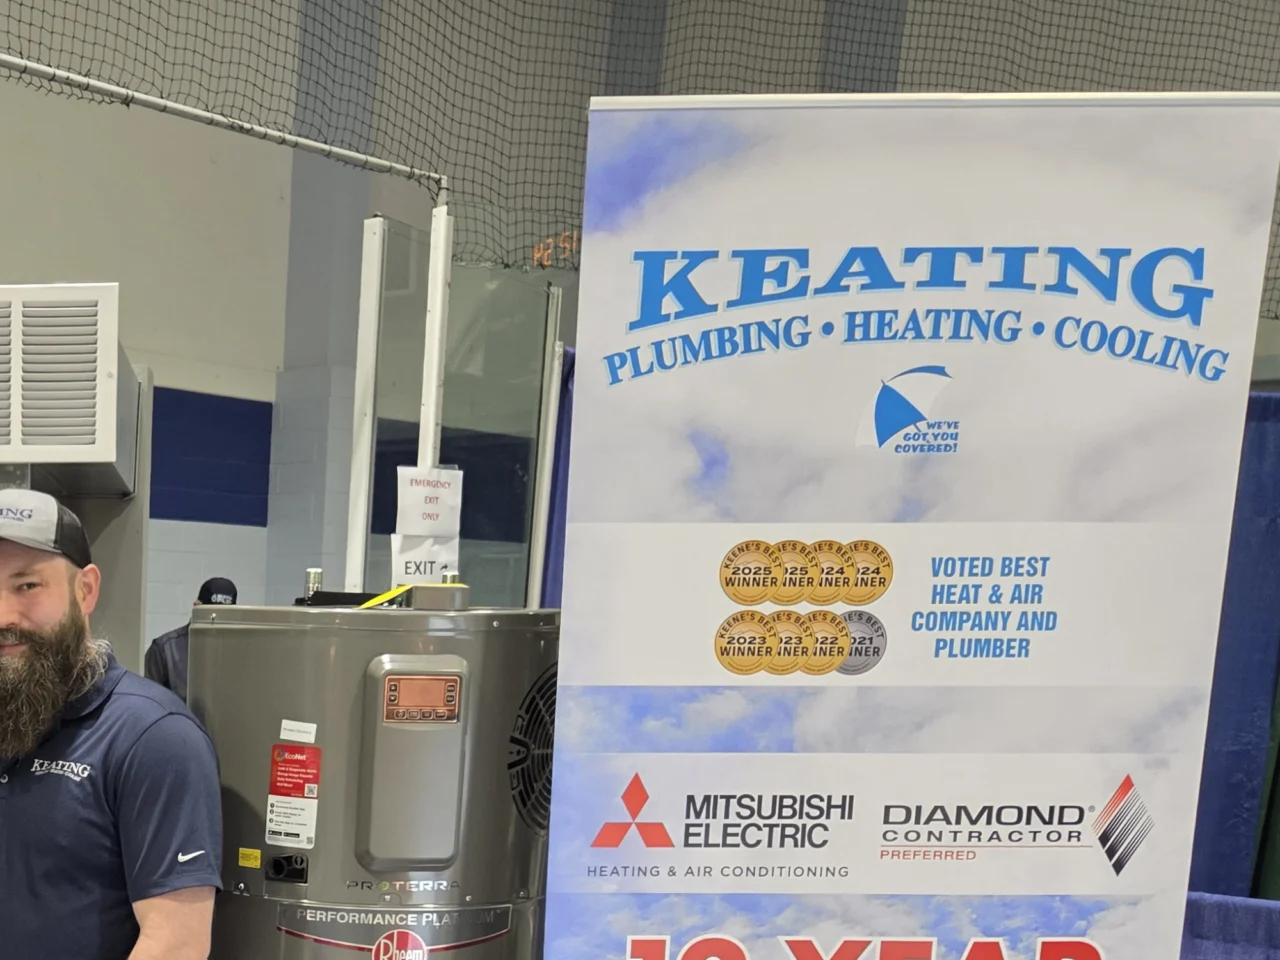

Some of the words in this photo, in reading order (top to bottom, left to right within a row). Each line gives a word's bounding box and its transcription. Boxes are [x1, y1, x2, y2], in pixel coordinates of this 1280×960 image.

[626, 246, 1215, 334] KEATING
[604, 314, 811, 387] PLUMBING
[842, 308, 1024, 344] HEATING
[1054, 316, 1231, 384] COOLING
[926, 421, 960, 430] WE'VE
[903, 432, 928, 442] GOT
[932, 432, 959, 441] YOU
[894, 443, 958, 453] COVERED!
[410, 479, 451, 489] EMERGENCY
[424, 496, 439, 504] EXIT
[422, 512, 439, 520] ONLY
[724, 542, 761, 569] KEENE'S
[763, 544, 781, 568] BEST
[799, 544, 818, 569] BEST
[836, 544, 854, 568] BEST
[871, 544, 890, 569] BEST
[405, 561, 436, 575] EXIT
[731, 566, 772, 576] 2025
[930, 557, 993, 578] VOTED
[999, 556, 1051, 577] BEST
[725, 577, 777, 587] WINNER
[931, 583, 983, 605] HEAT
[988, 584, 1005, 604] &
[1009, 584, 1044, 604] AIR
[719, 612, 756, 639] KEENE'S
[758, 614, 776, 638] BEST
[794, 614, 813, 638] BEST
[830, 614, 849, 638] BEST
[866, 614, 884, 638] BEST
[910, 610, 1011, 632] COMPANY
[1016, 611, 1058, 631] AND
[726, 636, 767, 645] 2023
[934, 638, 1031, 659] PLUMBER
[720, 646, 773, 656] WINNER
[284, 752, 307, 760] EcoNet
[31, 759, 91, 777] KEATING
[684, 793, 855, 821] MITSUBISHI
[882, 805, 1085, 827] DIAMOND
[683, 822, 830, 849] ELECTRIC
[881, 830, 1083, 843] CONTRACTOR
[879, 849, 977, 861] PREFERRED
[587, 866, 660, 878] HEATING
[666, 866, 678, 878] &
[685, 866, 714, 878] AIR
[720, 866, 850, 878] CONDITIONING
[346, 880, 461, 891] PROTERRA
[297, 909, 418, 926] PERFORMANCE
